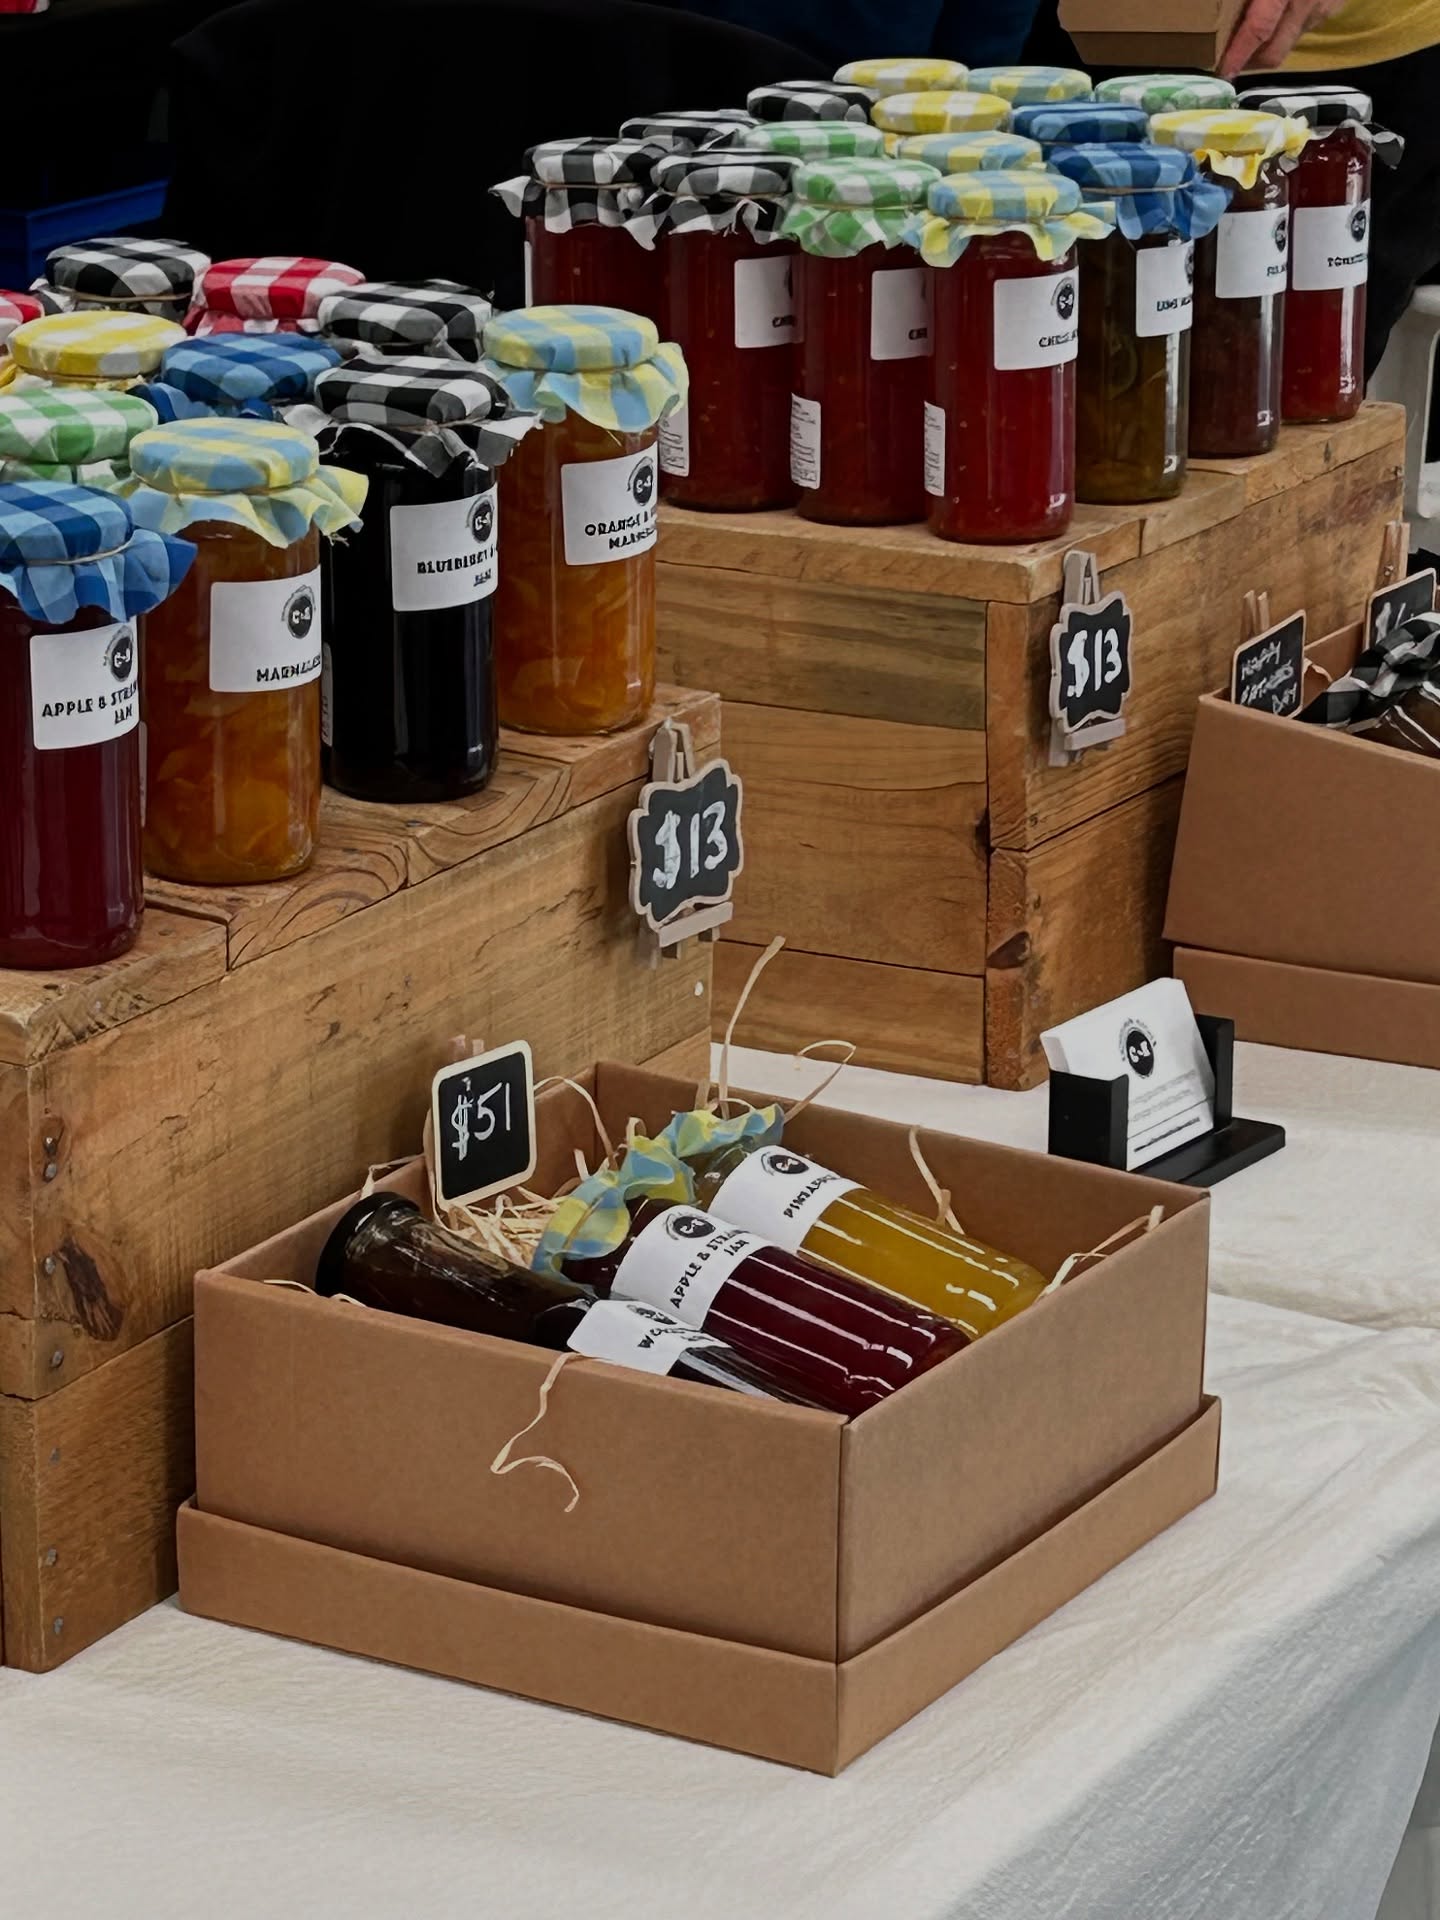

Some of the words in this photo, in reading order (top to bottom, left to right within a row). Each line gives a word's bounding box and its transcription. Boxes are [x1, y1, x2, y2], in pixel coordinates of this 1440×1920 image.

[1066, 628, 1123, 699] $13
[42, 698, 93, 717] APPLE
[652, 801, 728, 889] $13
[451, 1076, 511, 1161] $51
[669, 1262, 702, 1309] APPLE
